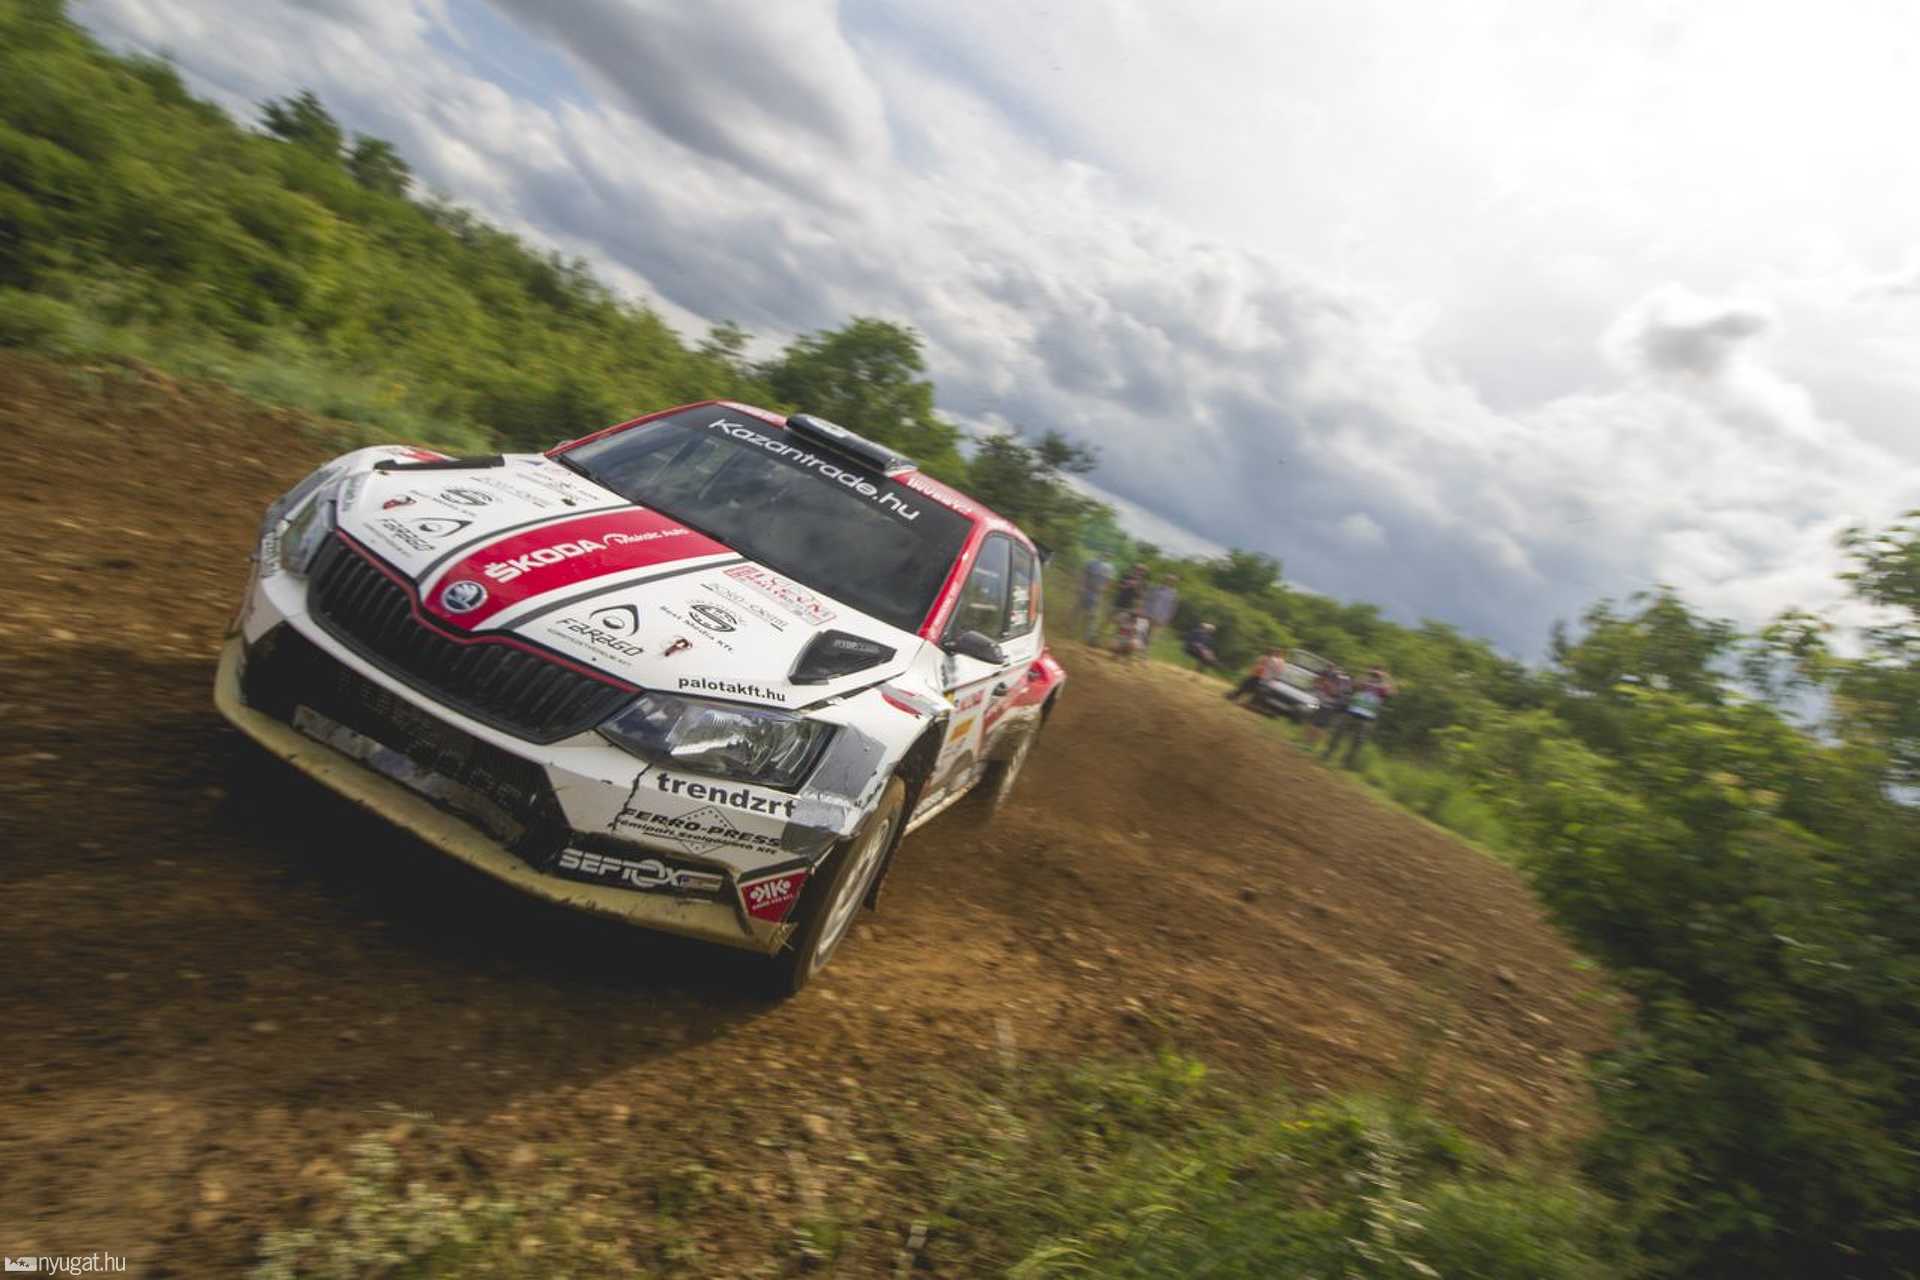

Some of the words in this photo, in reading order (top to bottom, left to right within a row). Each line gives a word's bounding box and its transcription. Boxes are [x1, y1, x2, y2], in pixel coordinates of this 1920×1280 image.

[483, 539, 608, 583] ŠKODA
[677, 677, 786, 702] palotakft.hu
[656, 772, 798, 818] trendzrt
[620, 807, 783, 847] FERRO-PRESS
